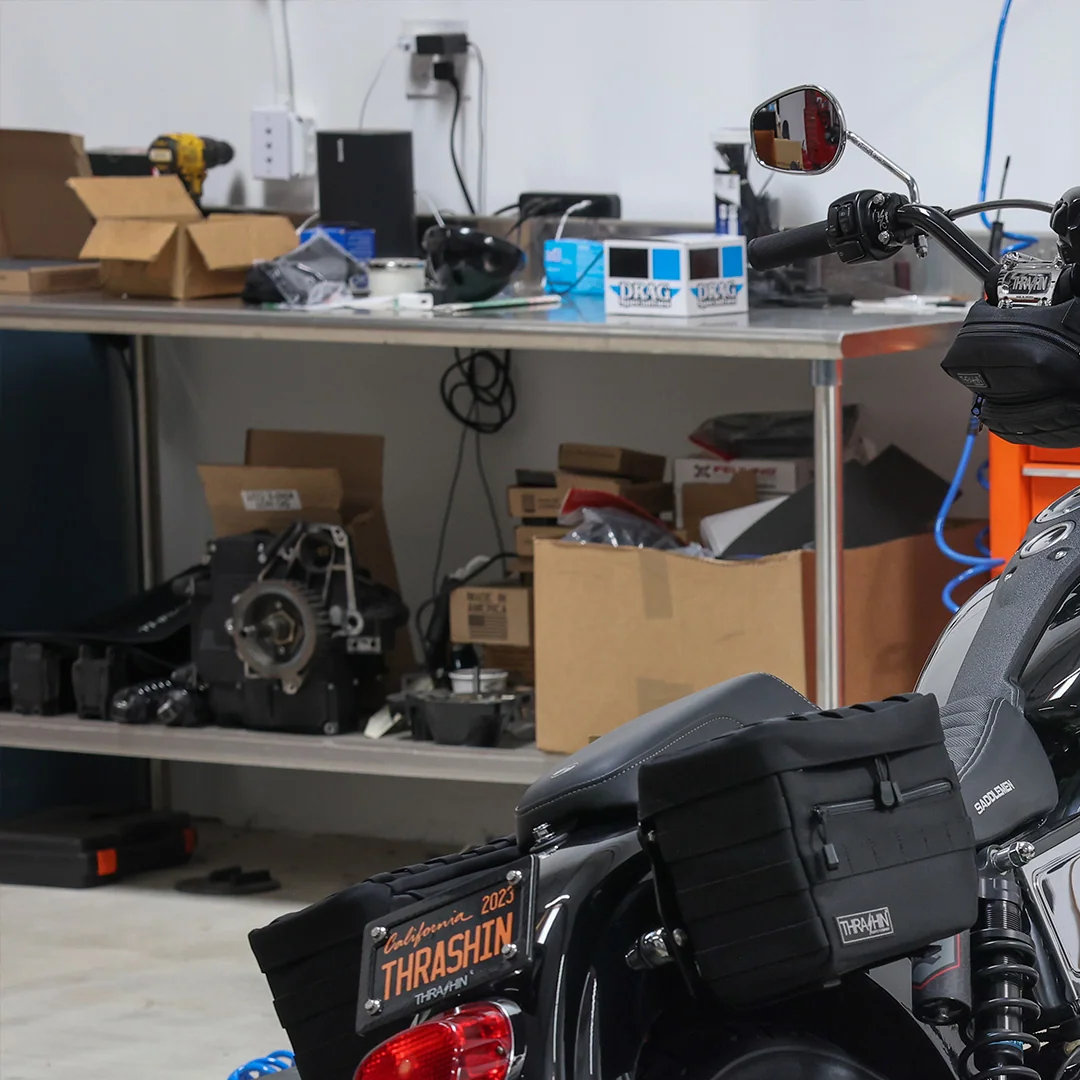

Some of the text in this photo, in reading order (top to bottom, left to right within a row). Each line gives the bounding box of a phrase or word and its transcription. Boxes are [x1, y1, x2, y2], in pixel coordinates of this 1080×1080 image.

[619, 281, 672, 301] DRAG
[698, 281, 738, 301] DRAG
[974, 779, 1015, 815] SADDLEMEN
[384, 885, 515, 955] California 2023
[381, 911, 514, 1001] THRASHIN
